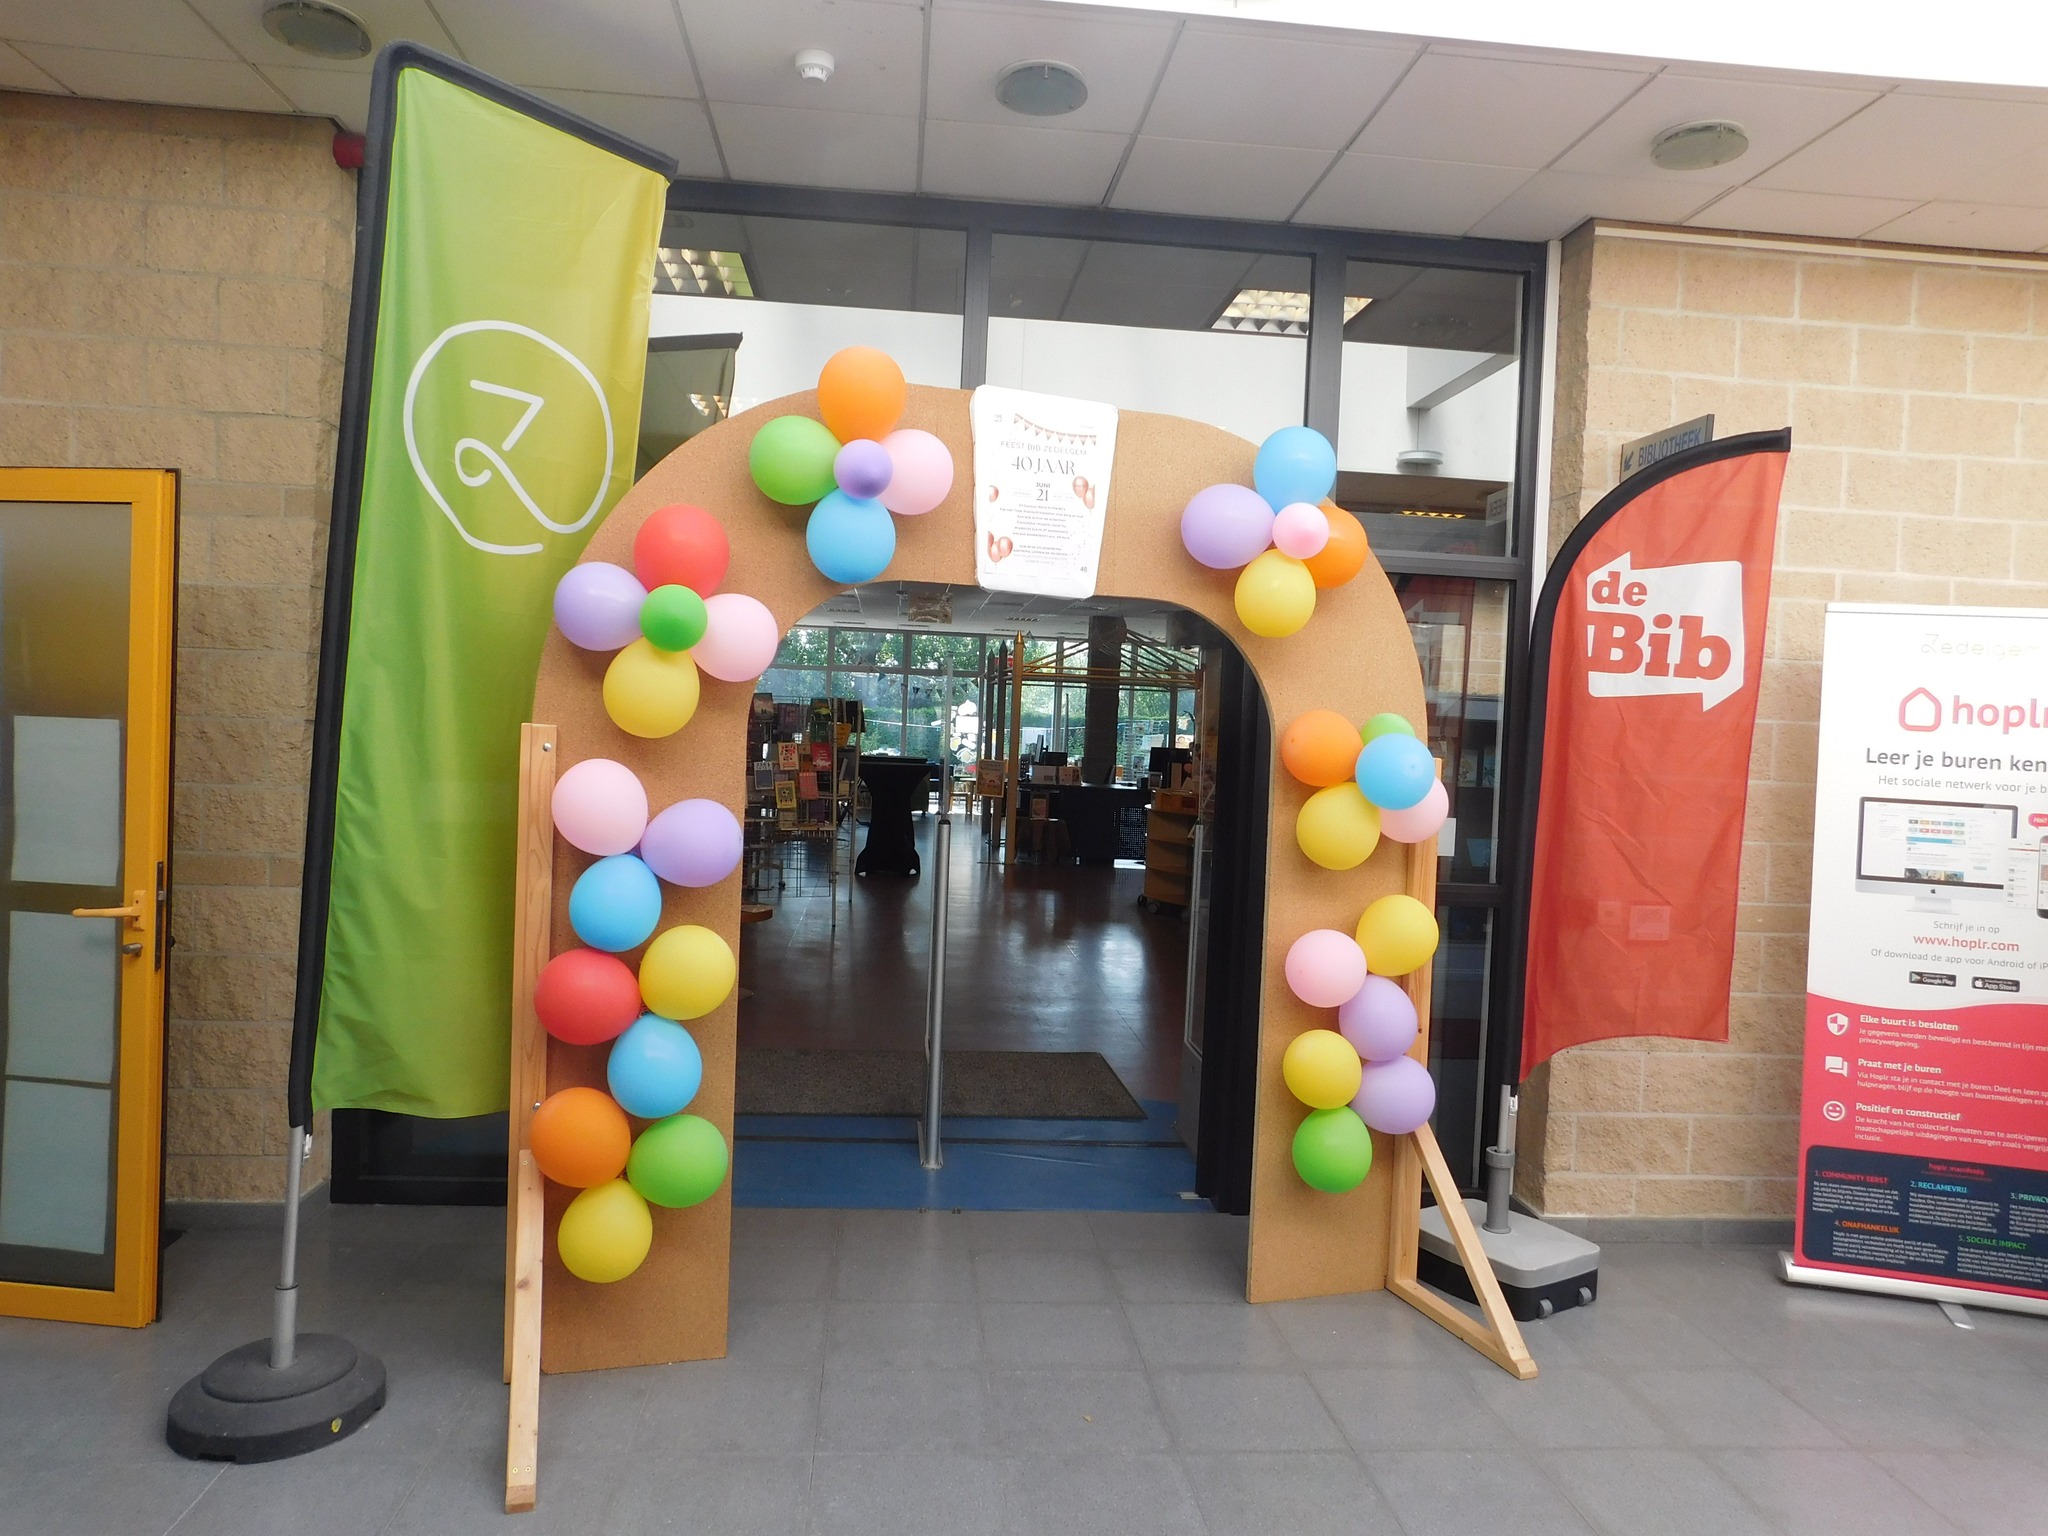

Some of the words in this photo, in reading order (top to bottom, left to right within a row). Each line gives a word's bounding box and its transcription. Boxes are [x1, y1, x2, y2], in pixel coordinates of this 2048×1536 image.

[1638, 428, 1702, 467] BIBLIOTHEEK
[1011, 456, 1033, 471] 40
[1034, 457, 1075, 475] JAAR
[1036, 489, 1049, 501] 21
[1591, 571, 1648, 607] de
[1588, 613, 1732, 681] Bib
[1866, 747, 1910, 765] Leer
[1915, 750, 1934, 770] je
[1942, 752, 2001, 770] buren
[2010, 755, 2047, 773] ken
[1878, 775, 1899, 786] Het
[1902, 777, 1941, 788] sociale
[1945, 780, 1992, 791] netwerk
[1995, 783, 2021, 792] voor
[2025, 782, 2036, 795] je
[1933, 921, 1963, 932] Schrijf
[1965, 924, 1974, 933] je
[1977, 924, 1985, 932] in
[1988, 926, 2000, 934] op
[1913, 935, 2020, 952] www.hoplr.com
[1871, 948, 1881, 957] Of
[1884, 949, 1928, 961] download
[1931, 953, 1943, 962] de
[1945, 956, 1962, 964] app
[1965, 958, 1985, 966] voor
[1988, 958, 2024, 969] Android
[2027, 962, 2037, 970] of
[1860, 1014, 1879, 1023] Elke
[1881, 1017, 1906, 1026] buurt
[1908, 1019, 1916, 1027] is
[1918, 1020, 1958, 1031] besloten
[1867, 1030, 1899, 1038] gegevens
[1972, 1038, 2011, 1048] beschermd
[1858, 1058, 1882, 1068] Praat
[1884, 1062, 1902, 1070] met
[1903, 1063, 1913, 1072] je
[1914, 1064, 1942, 1074] buren
[1919, 1078, 1945, 1086] contact
[1994, 1085, 2010, 1093] Deel
[1934, 1088, 1959, 1097] hoogte
[1856, 1102, 1890, 1113] Positief
[1892, 1107, 1903, 1115] en
[1905, 1109, 1961, 1121] constructief
[1866, 1117, 1887, 1125] kracht
[1916, 1122, 1949, 1132] collectief
[1950, 1126, 1982, 1135] benutten
[1973, 1138, 2001, 1147] morgen
[2002, 1141, 2022, 1149] zoals
[1966, 1236, 1998, 1246] SOCIALE
[1998, 1240, 2027, 1249] IMPACT
